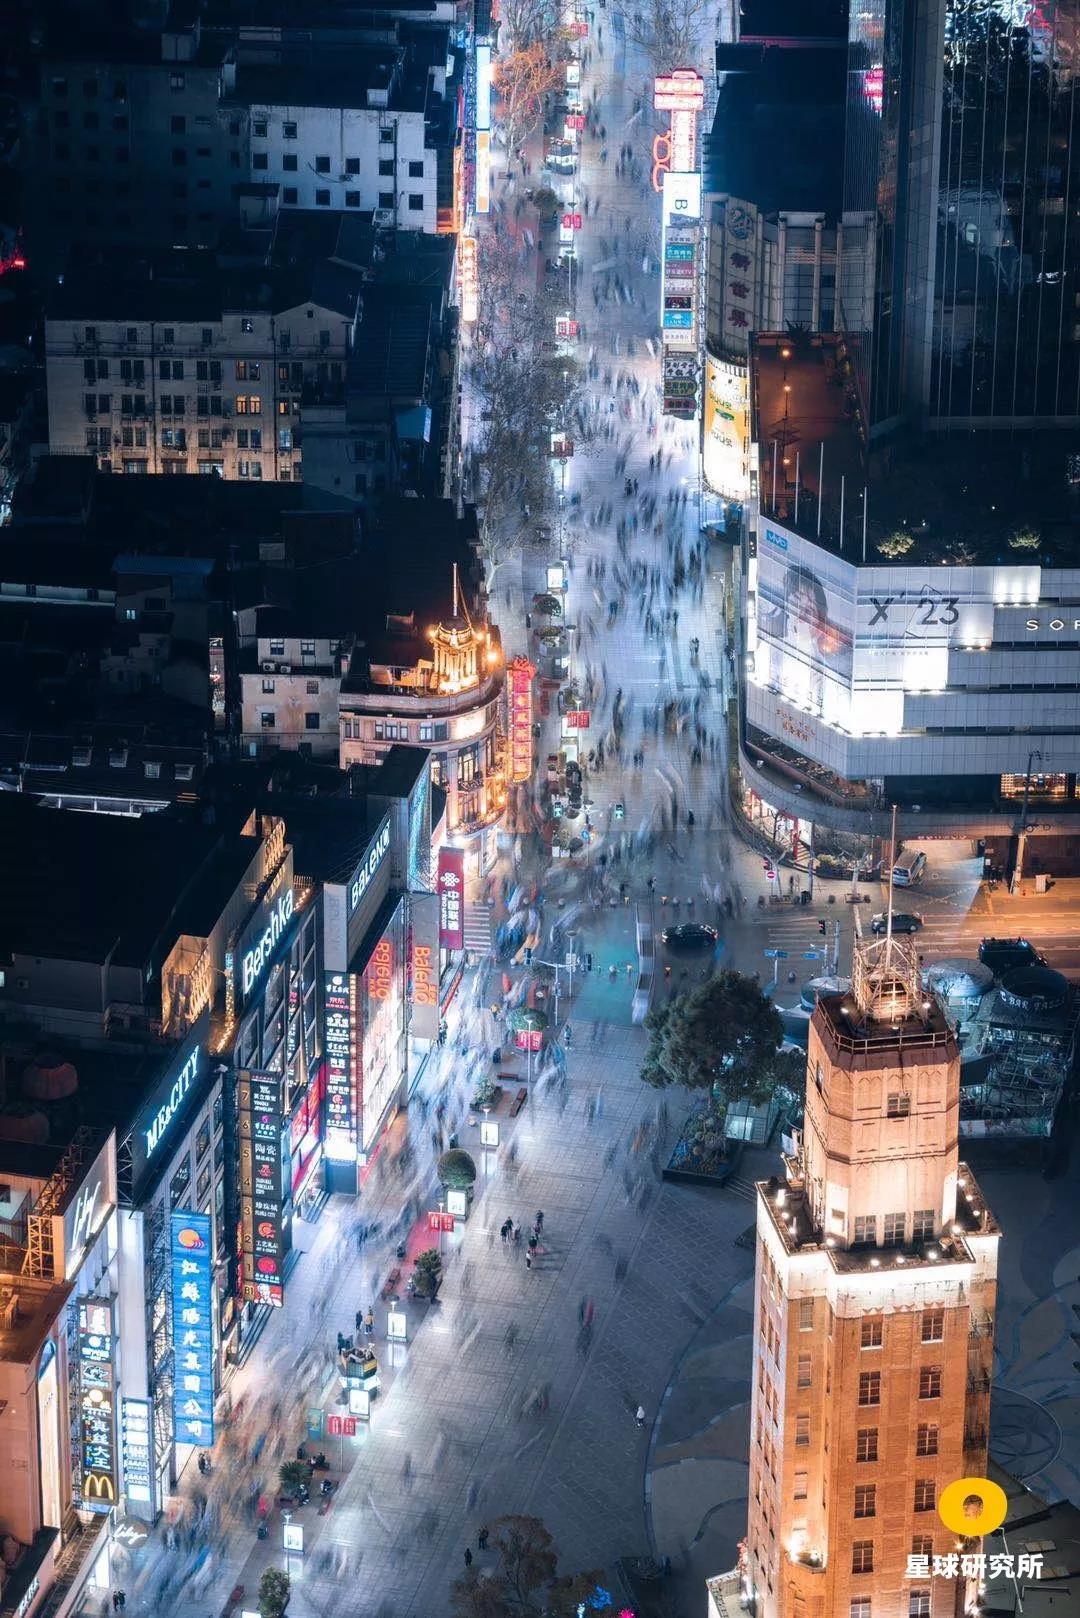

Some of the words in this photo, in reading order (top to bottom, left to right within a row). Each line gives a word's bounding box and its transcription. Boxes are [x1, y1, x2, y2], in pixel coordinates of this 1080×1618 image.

[243, 888, 293, 995] Bershka
[241, 1090, 250, 1101] 7
[242, 1119, 249, 1130] 6
[243, 1149, 250, 1159] 5
[243, 1177, 250, 1187] 4
[244, 1206, 251, 1216] 3
[244, 1235, 251, 1244] 2
[244, 1286, 254, 1295] B1
